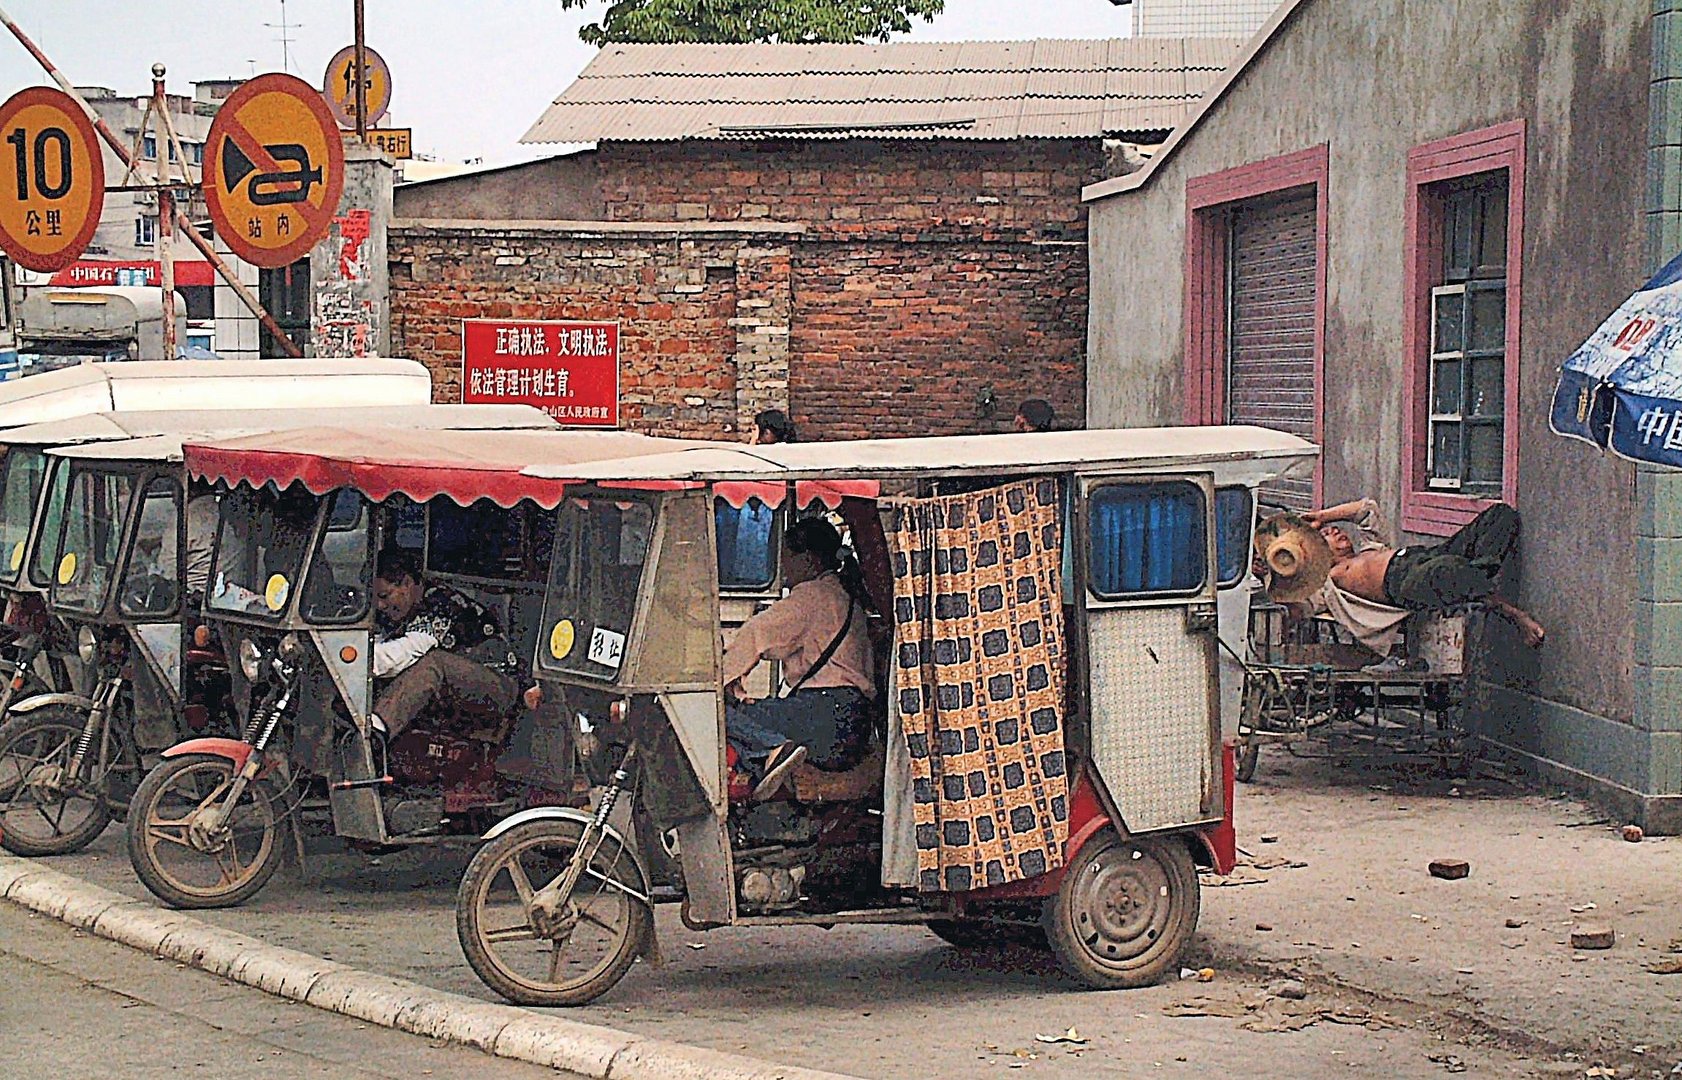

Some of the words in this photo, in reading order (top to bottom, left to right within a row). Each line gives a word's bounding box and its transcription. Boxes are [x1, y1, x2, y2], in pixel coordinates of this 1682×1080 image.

[7, 127, 72, 200] 10
[26, 209, 62, 236] 公里
[248, 213, 290, 238] 站内
[469, 367, 575, 397] 依法管理计划生育。
